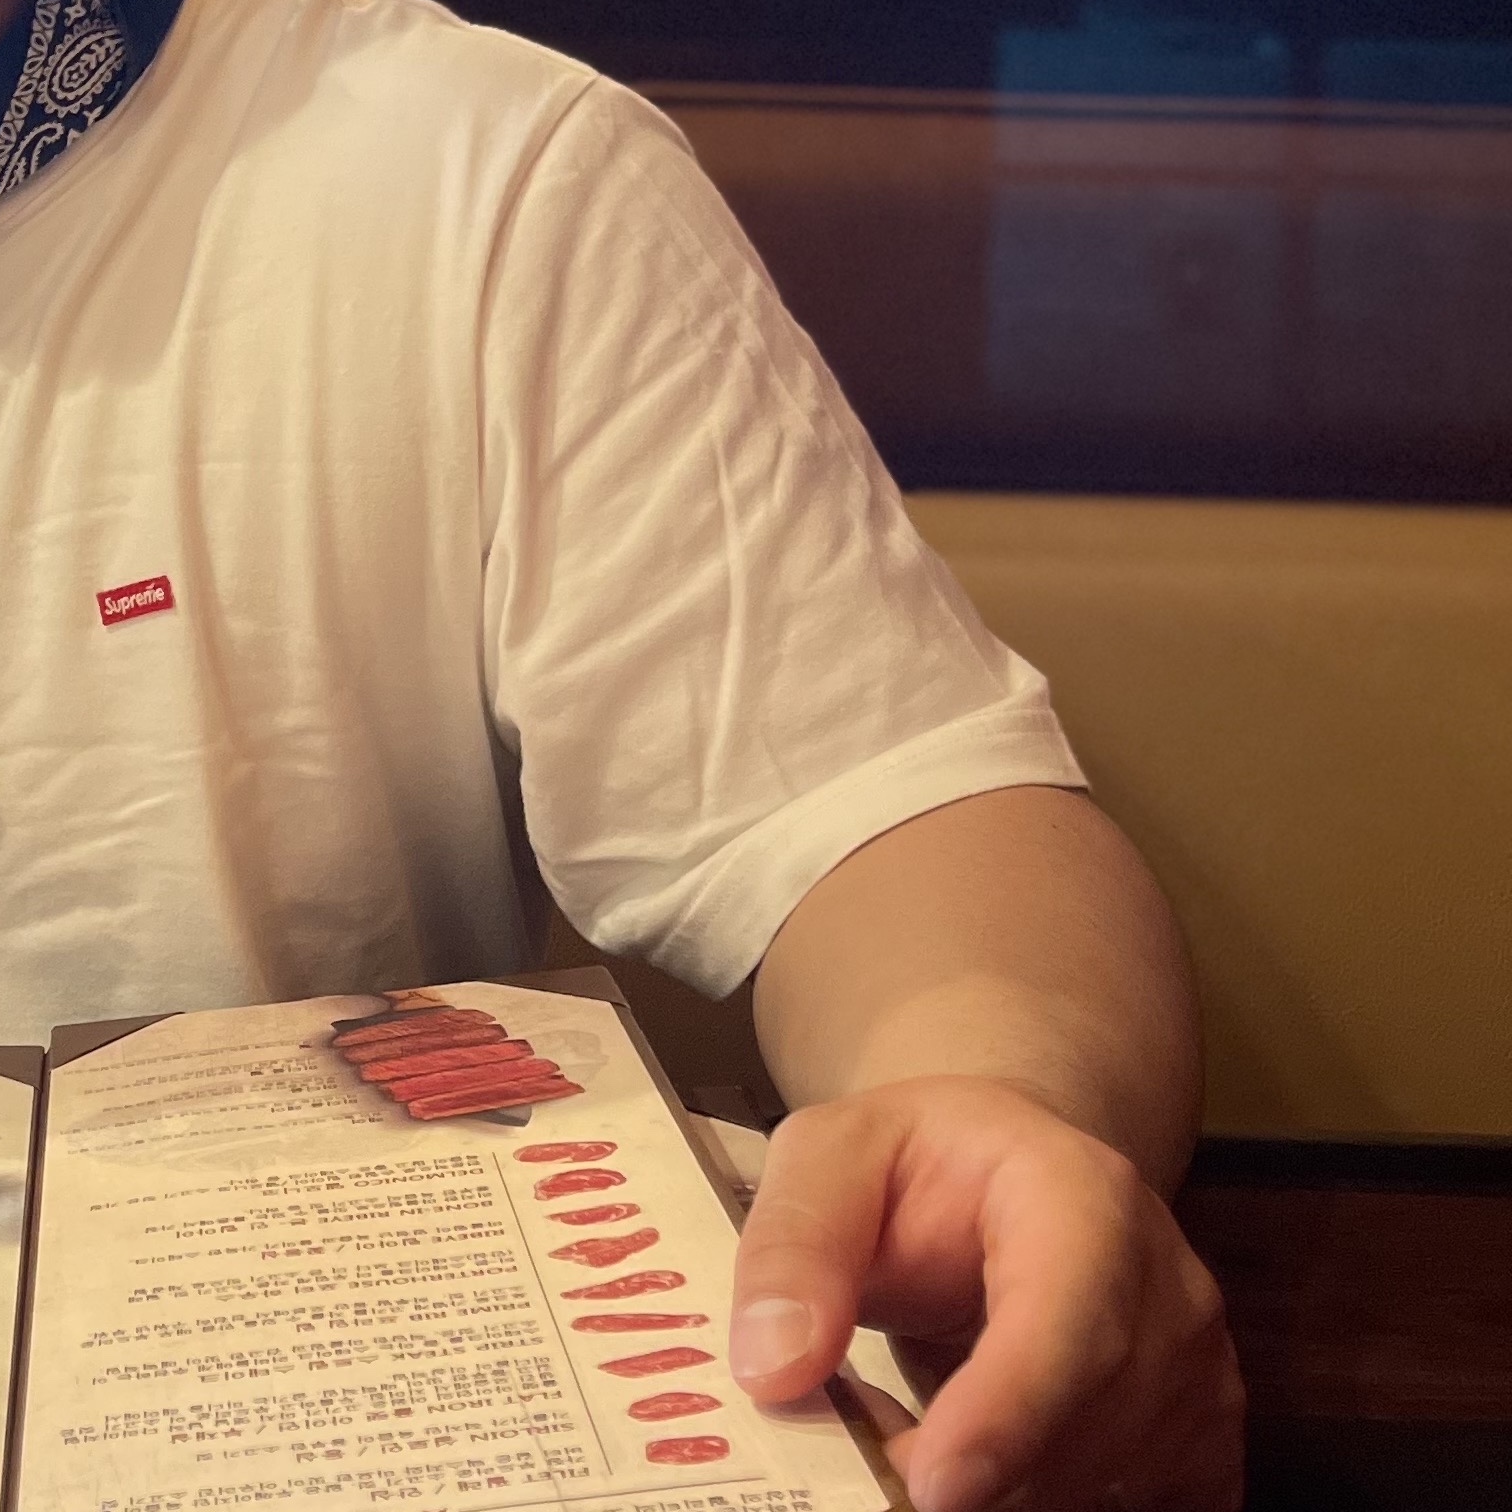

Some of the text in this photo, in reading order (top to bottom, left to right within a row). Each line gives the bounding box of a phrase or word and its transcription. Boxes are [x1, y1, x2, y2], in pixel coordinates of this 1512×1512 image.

[353, 1167, 484, 1189] DELMONICO
[261, 1181, 345, 1198] 델모니코
[399, 1199, 494, 1217] BONE-IN
[317, 1210, 390, 1226] RIBEYE
[176, 1225, 238, 1239] 립아이
[431, 1228, 506, 1244] RIBEYE
[356, 1236, 421, 1252] 립아이
[348, 1263, 518, 1291] PORTERHOUSE
[215, 1288, 282, 1304] 하우스
[410, 1310, 447, 1322] RIB
[457, 1300, 531, 1317] PRIME
[295, 1322, 316, 1333] 립
[329, 1313, 398, 1332] 프라임
[198, 1337, 544, 1385] STRIP STEAK 스트립 스테이크
[428, 1398, 493, 1415] IRON
[503, 1390, 562, 1407] FLAT
[279, 1414, 353, 1432] 아이언
[296, 1421, 575, 1464] SIRLOIN 설로인 등심
[370, 1466, 590, 1503] FILET 필레 안심
